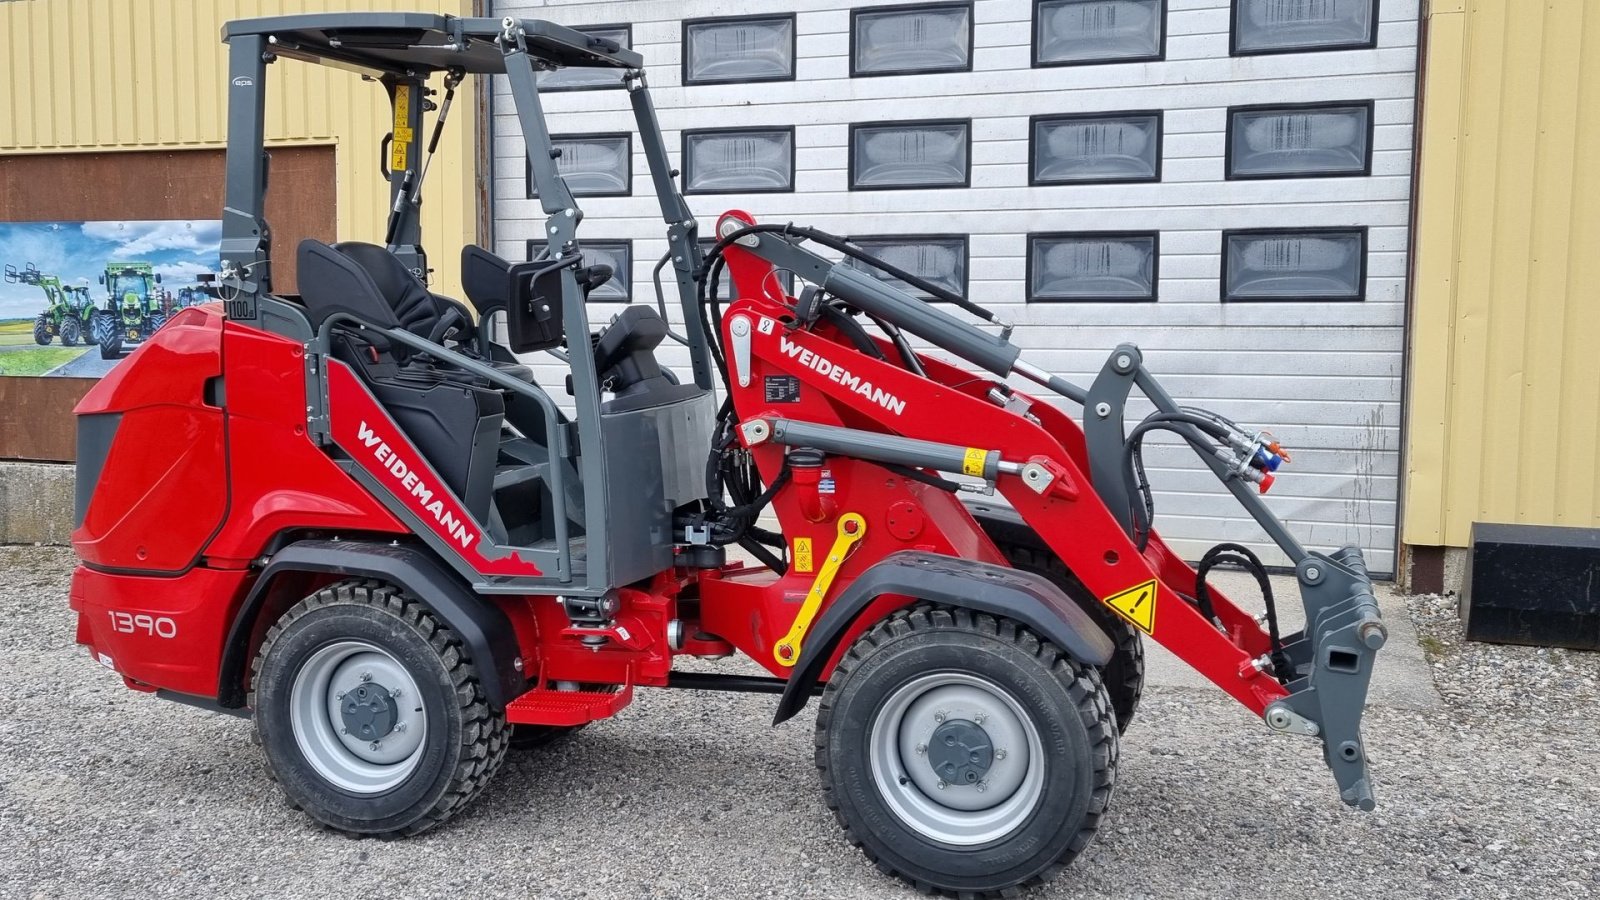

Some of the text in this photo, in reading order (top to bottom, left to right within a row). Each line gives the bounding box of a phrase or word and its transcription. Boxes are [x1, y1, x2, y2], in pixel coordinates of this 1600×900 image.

[232, 301, 248, 317] 100
[780, 336, 906, 415] WEIDEMANN
[357, 420, 474, 548] WEIDEMANN
[108, 610, 176, 638] 1390
